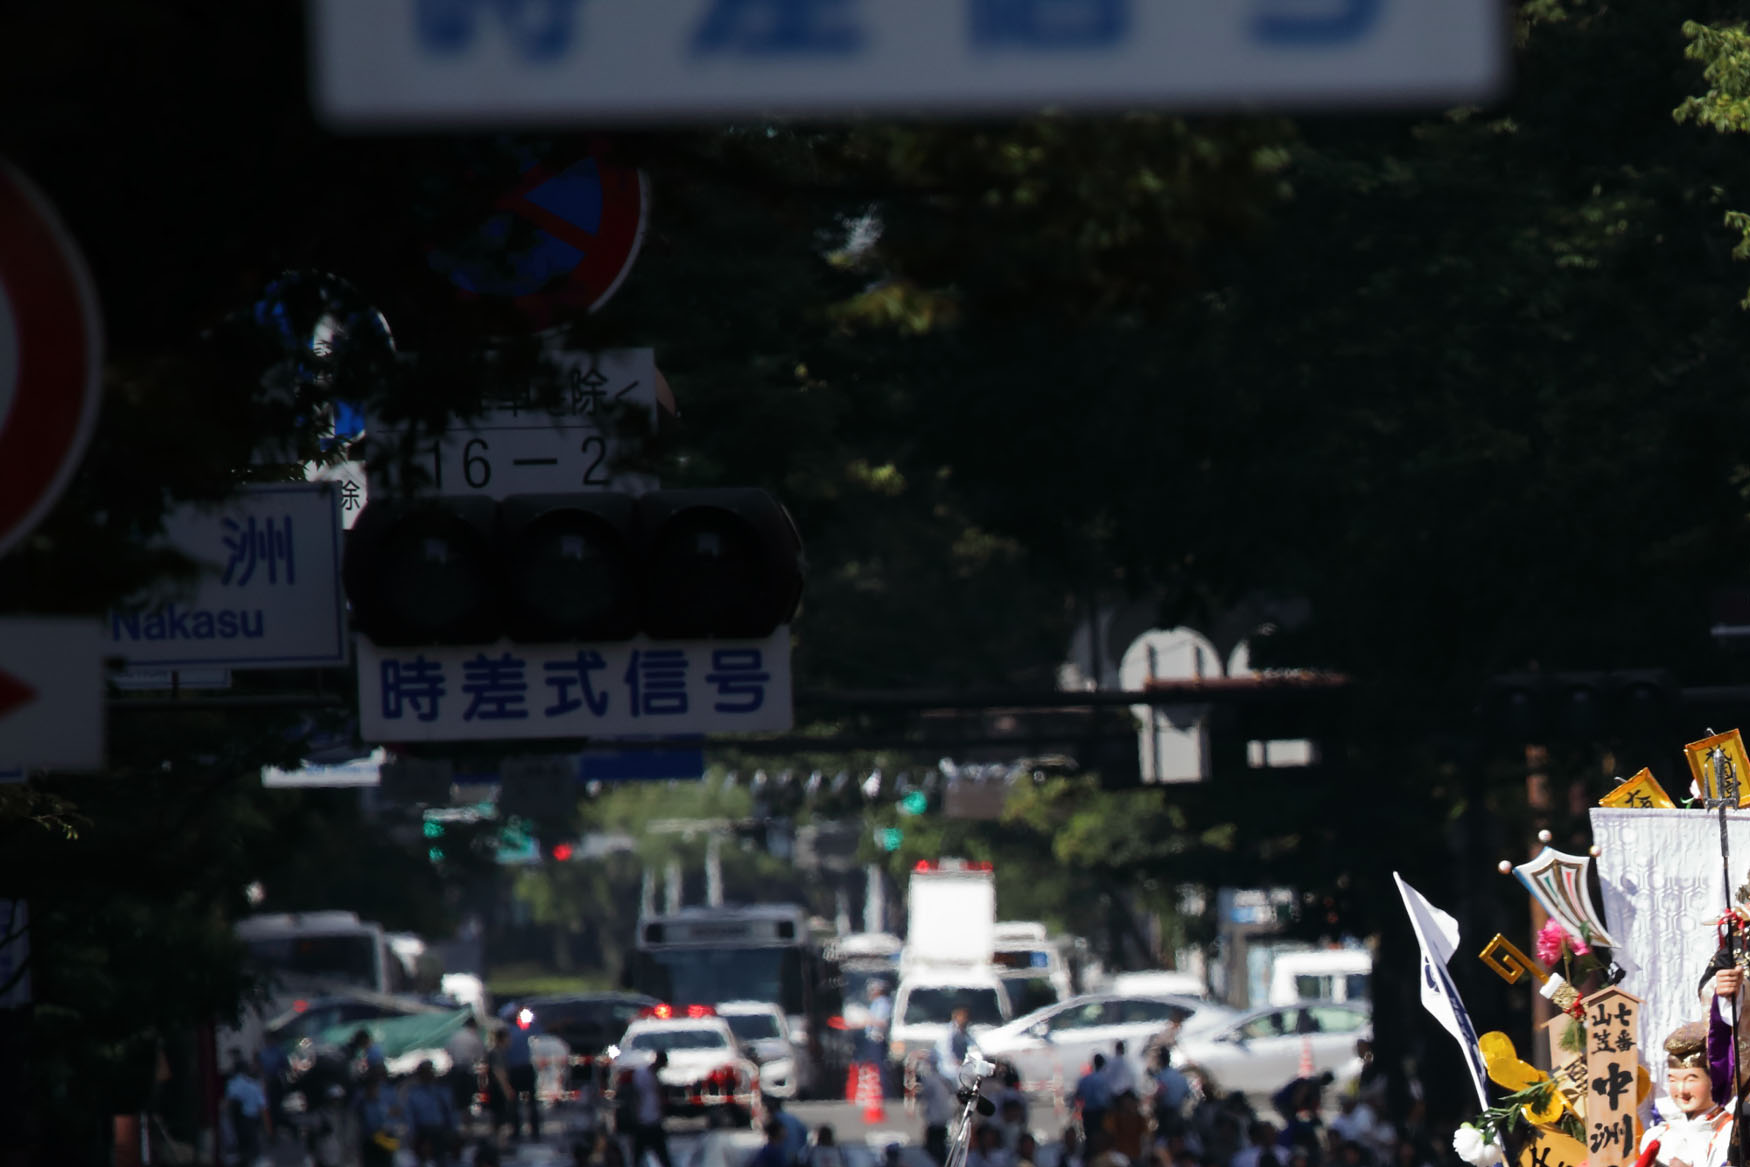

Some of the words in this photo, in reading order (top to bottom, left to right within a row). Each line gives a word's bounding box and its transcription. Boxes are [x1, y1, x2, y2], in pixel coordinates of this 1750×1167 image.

[111, 604, 265, 642] Nakasu
[380, 647, 772, 723] 時差式信号
[1591, 1003, 1616, 1055] 山笠
[1614, 1002, 1637, 1053] 七番
